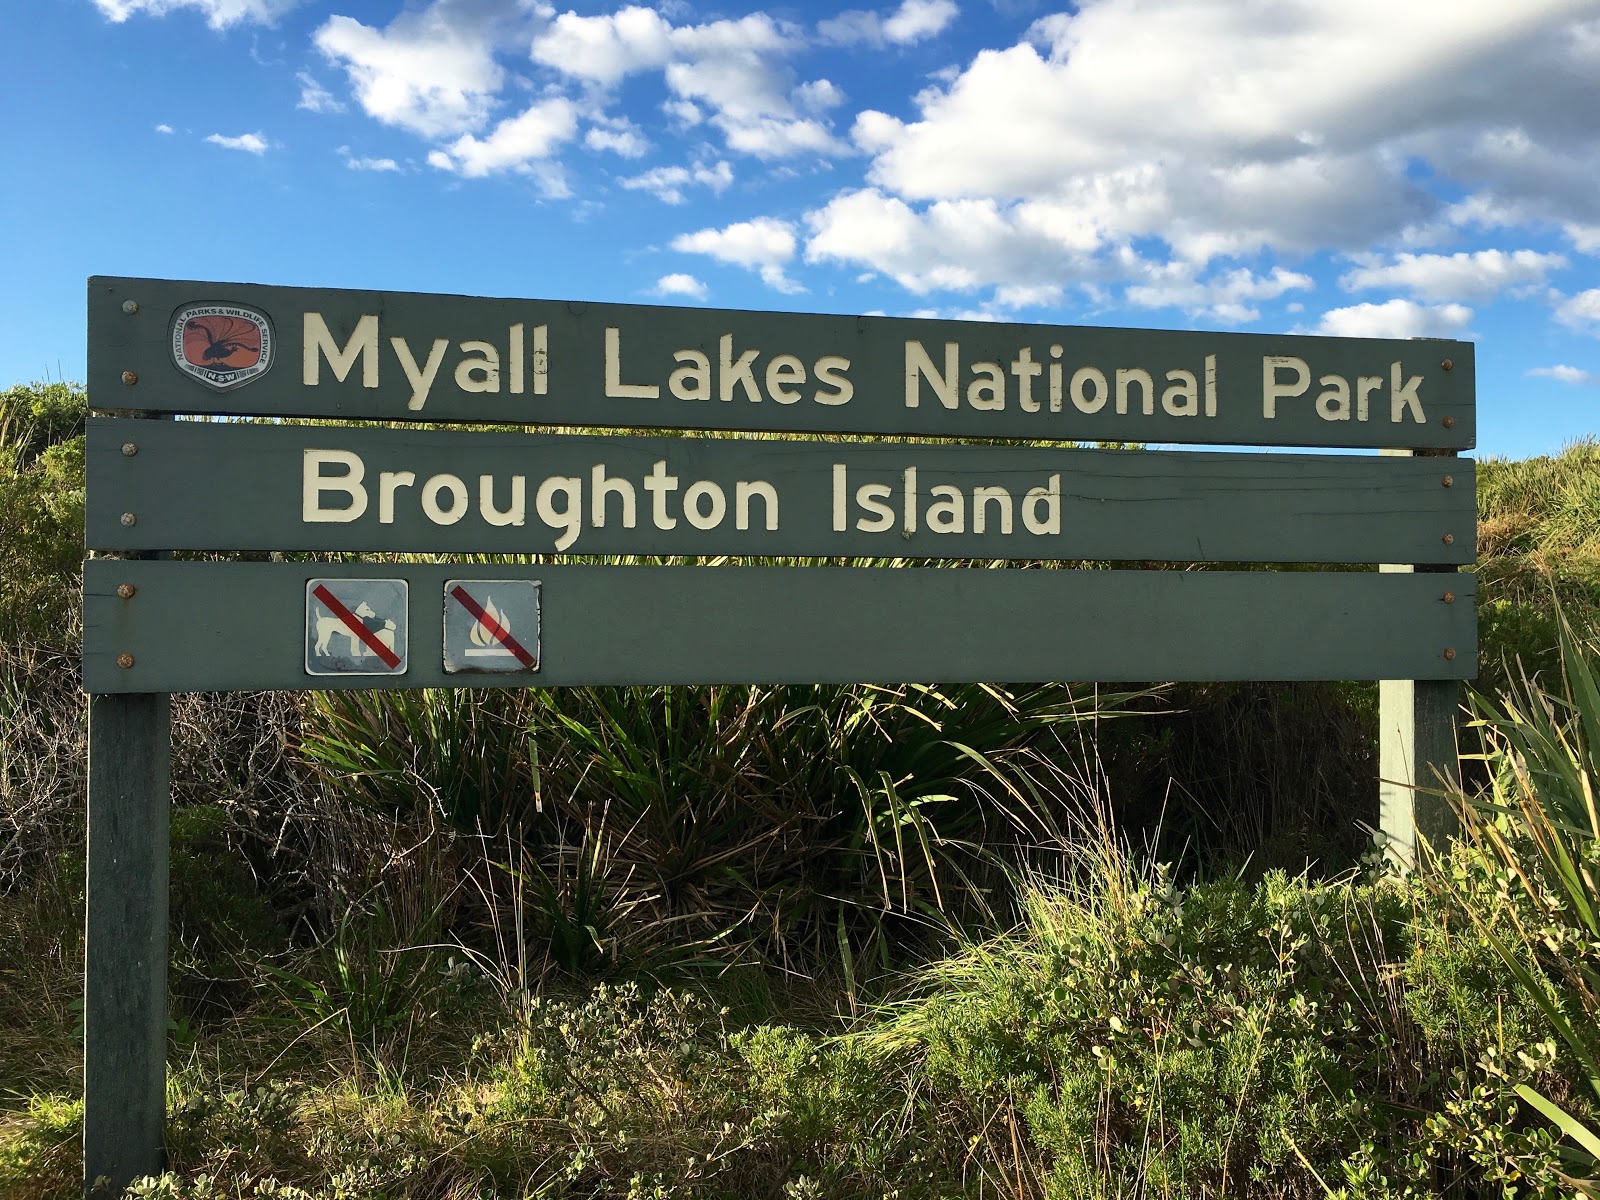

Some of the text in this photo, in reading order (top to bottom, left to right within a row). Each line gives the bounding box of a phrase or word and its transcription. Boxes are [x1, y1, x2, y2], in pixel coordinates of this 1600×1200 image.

[174, 317, 187, 361] NATIONAL
[186, 308, 217, 318] PARKS
[226, 309, 266, 328] WILDLIFE
[260, 328, 268, 365] SERVICE
[303, 312, 1427, 425] Myall Lakes National Park
[302, 448, 1062, 552] Broughton Island
